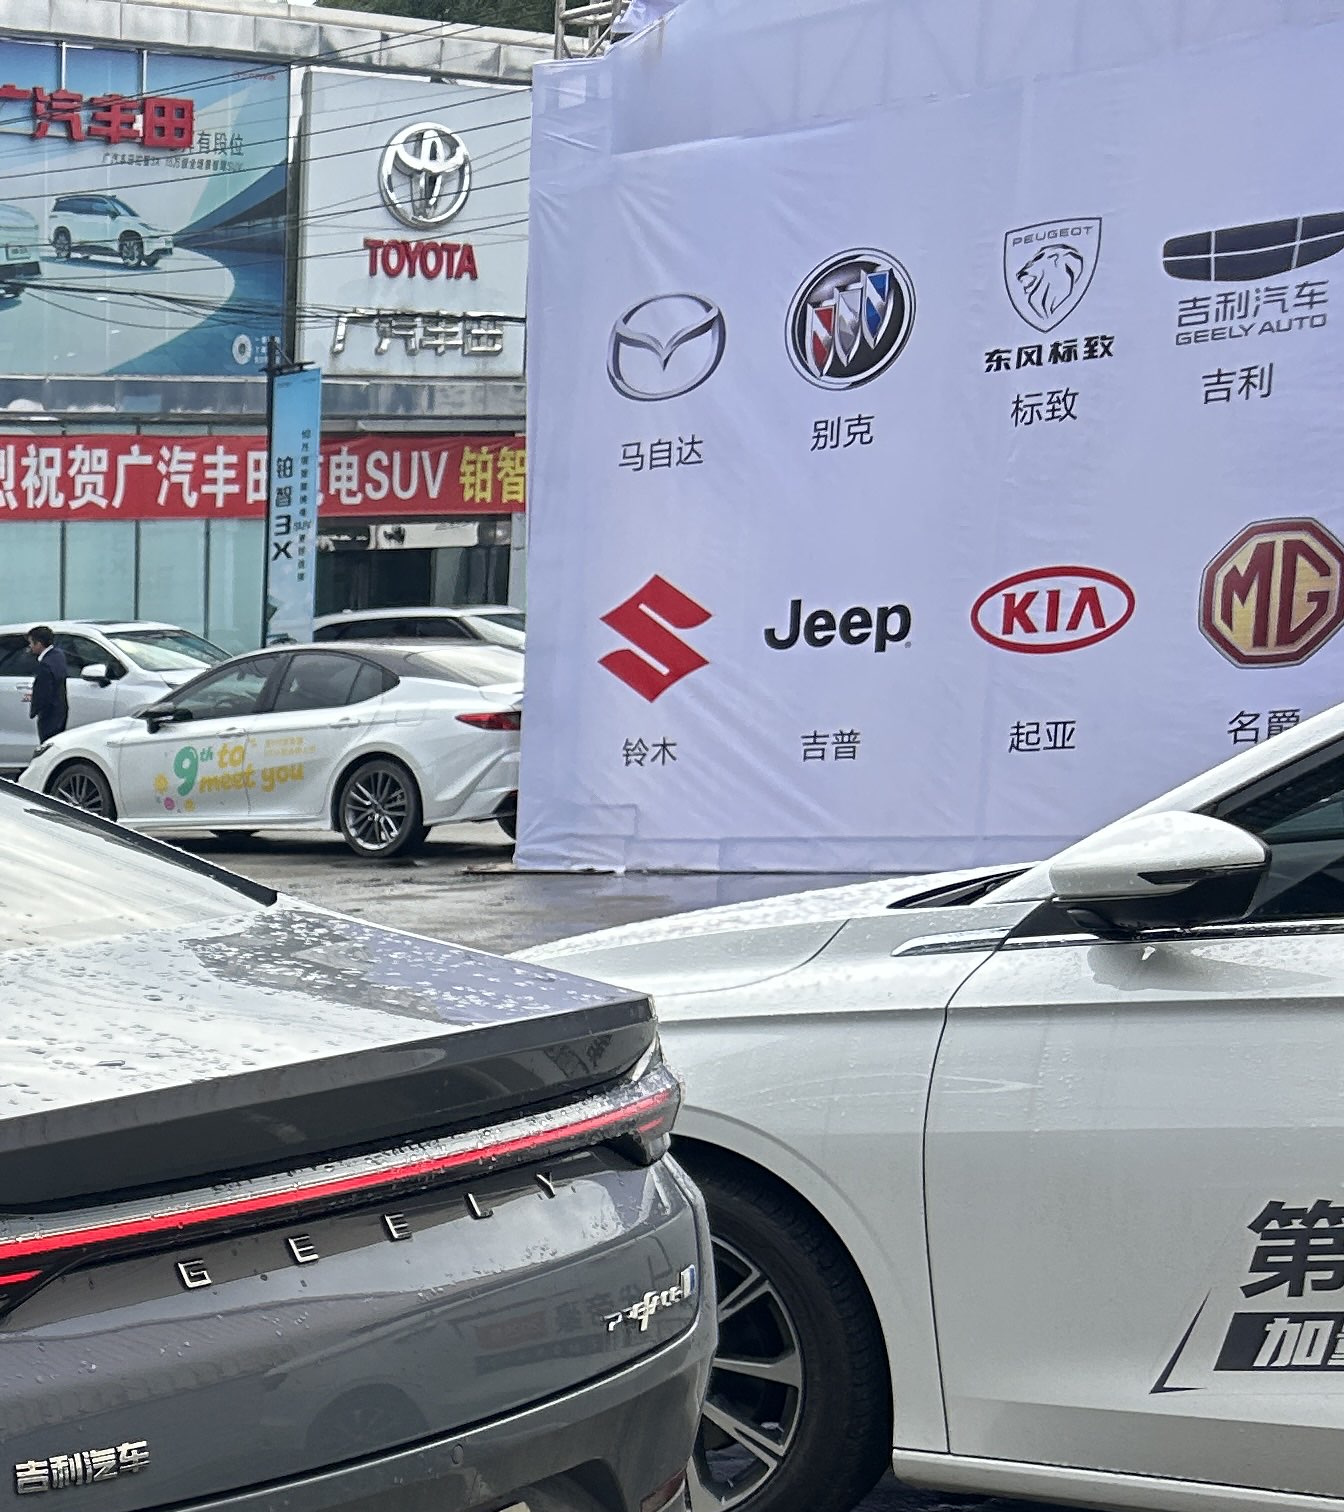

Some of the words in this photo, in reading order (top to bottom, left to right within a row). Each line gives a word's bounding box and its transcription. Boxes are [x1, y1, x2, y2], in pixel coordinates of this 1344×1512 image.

[1012, 223, 1094, 248] PEUGEOT
[364, 238, 479, 281] TOYOTA
[1176, 281, 1330, 328] 吉利汽车
[330, 306, 505, 356] 广汽丰田
[1175, 323, 1256, 347] GEELY
[1258, 312, 1327, 338] AUTO
[983, 334, 1116, 374] 东风标致
[1201, 364, 1273, 405] 吉利
[1010, 388, 1080, 427] 标致
[810, 415, 874, 451] 别克
[618, 437, 704, 472] 马自达
[272, 456, 293, 561] 铂智3X
[1001, 586, 1108, 636] KIA
[1220, 540, 1333, 651] MG
[764, 600, 912, 654] Jeep
[621, 737, 678, 768] 铃木
[801, 730, 862, 764] 吉普
[1008, 721, 1077, 754] 起亚
[174, 746, 214, 797] 9th
[217, 743, 245, 769] to
[199, 764, 256, 793] meet
[262, 762, 305, 792] you
[176, 1172, 557, 1290] GEELY
[1252, 1317, 1344, 1367] 加
[14, 1441, 151, 1495] 吉利汽车
